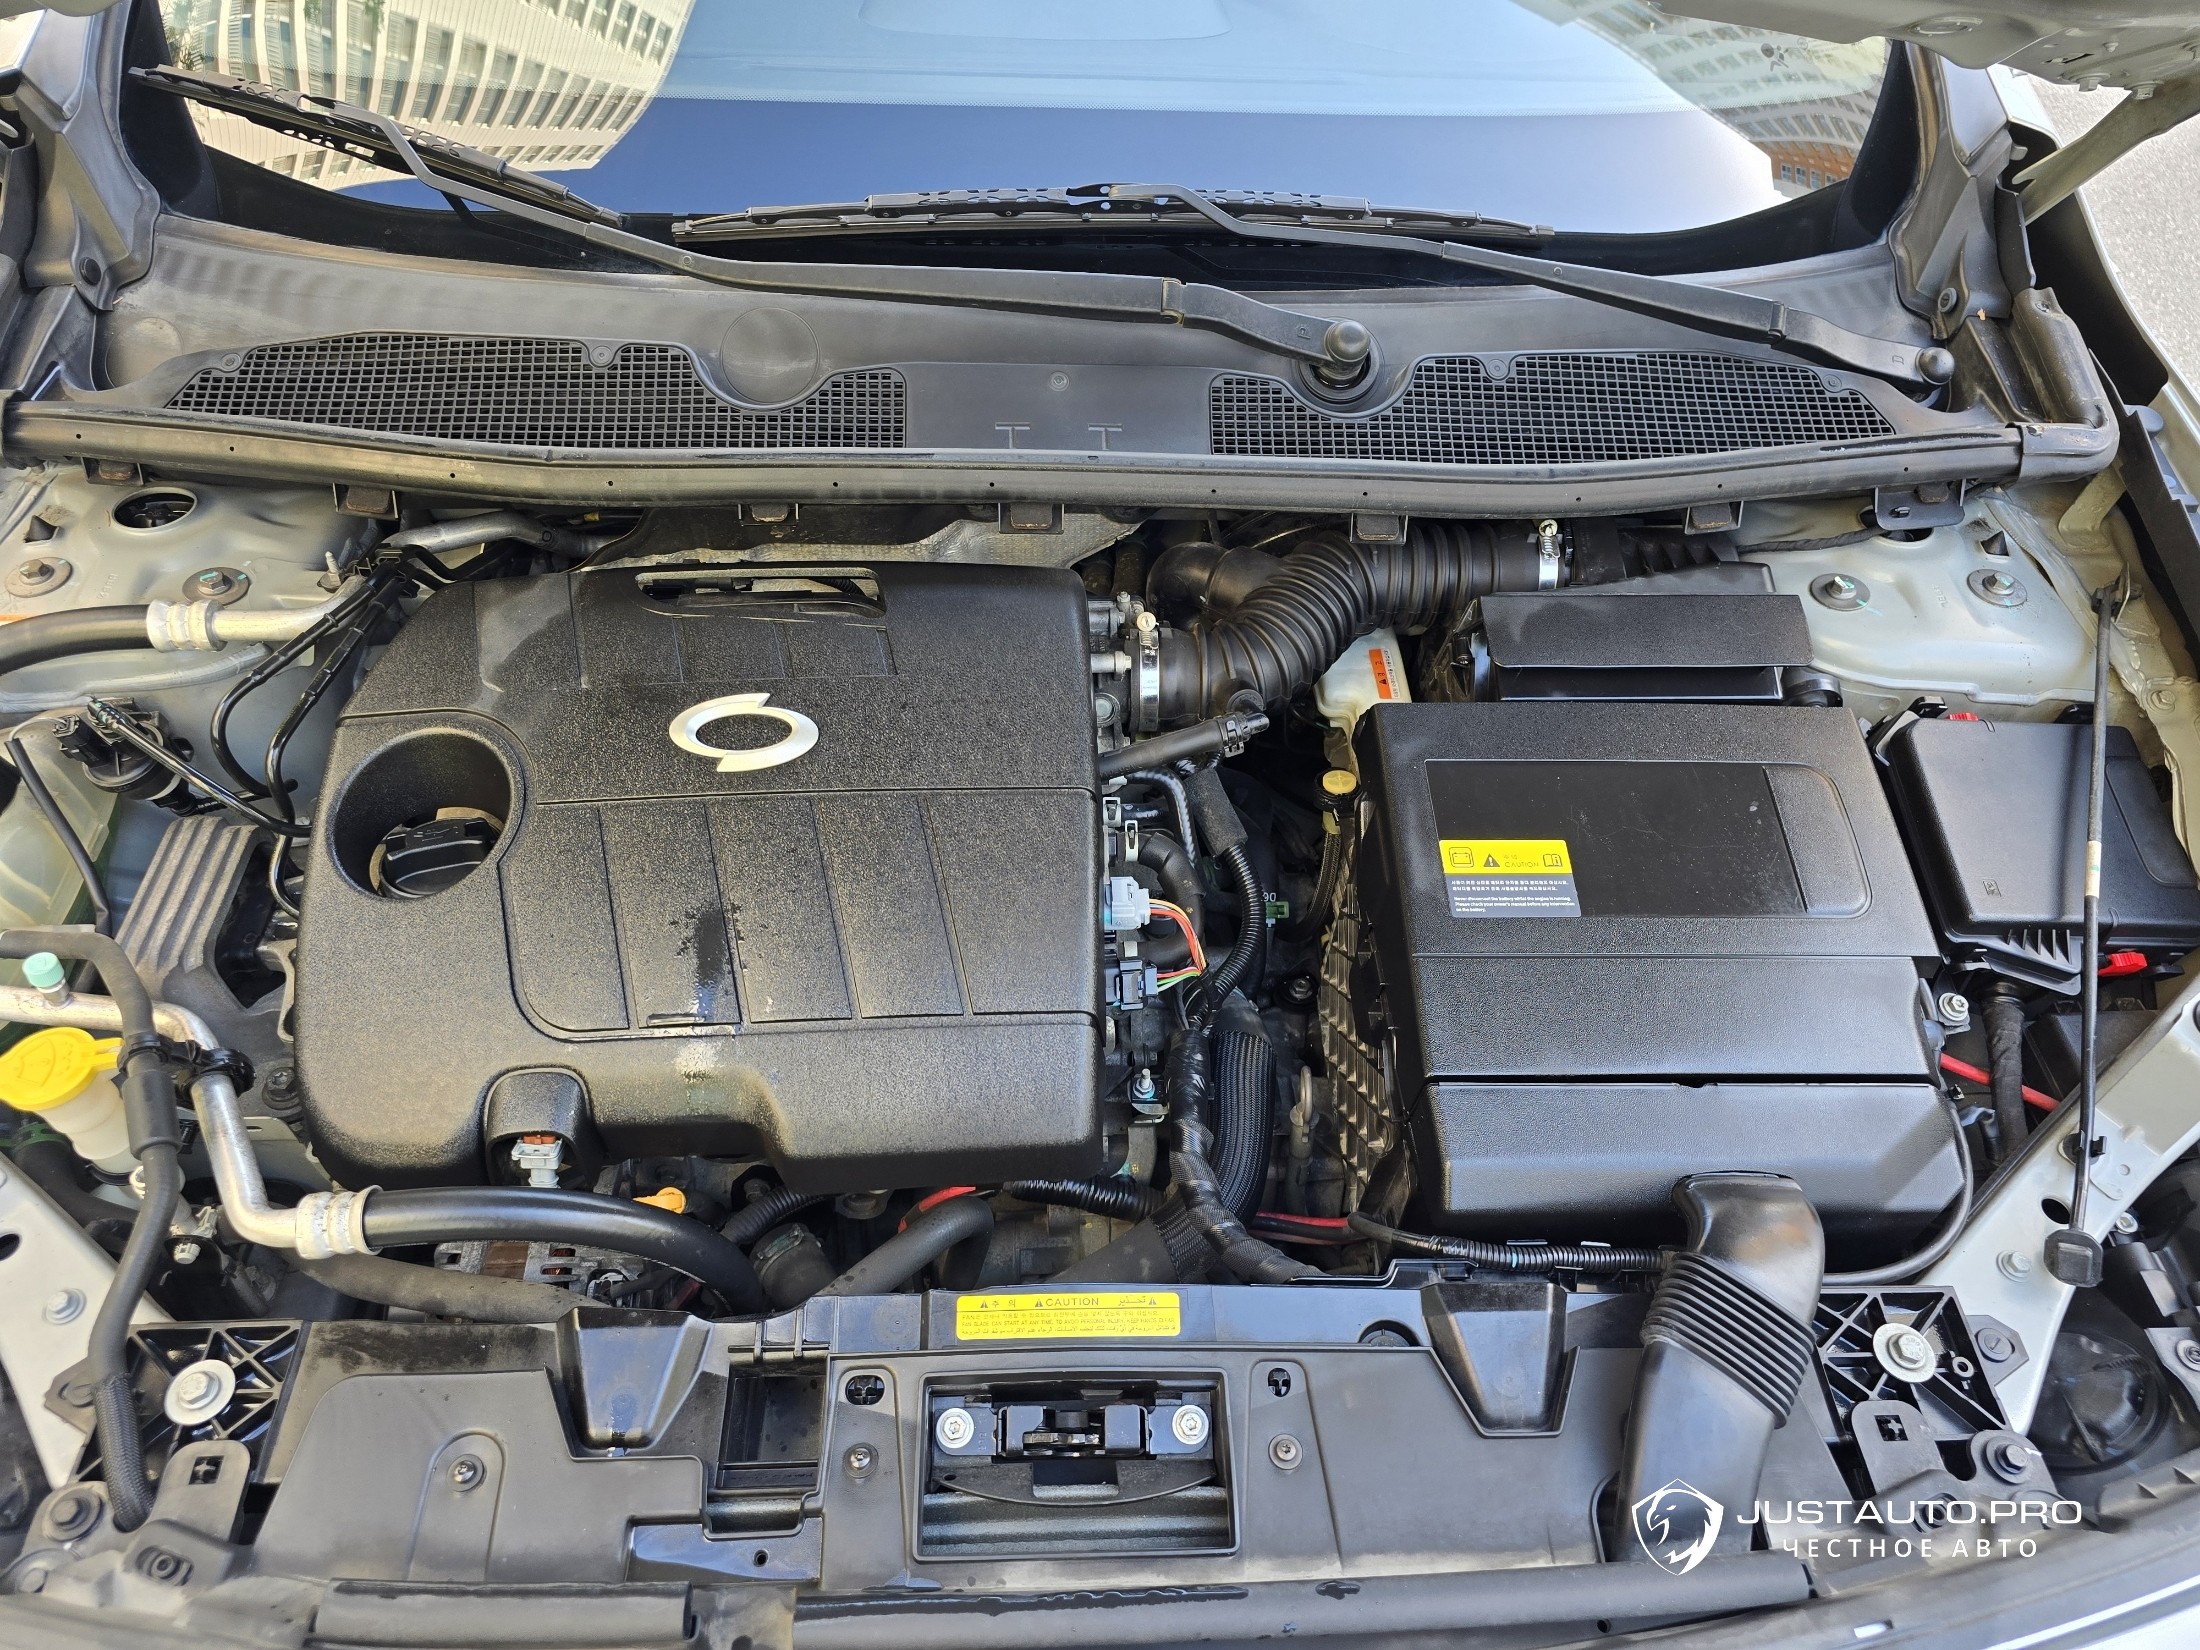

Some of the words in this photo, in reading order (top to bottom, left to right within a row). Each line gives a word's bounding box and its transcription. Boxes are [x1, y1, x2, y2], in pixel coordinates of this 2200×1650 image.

[991, 1300, 1000, 1308] 주
[1008, 1299, 1016, 1308] 의
[1046, 1297, 1099, 1307] CAUTION
